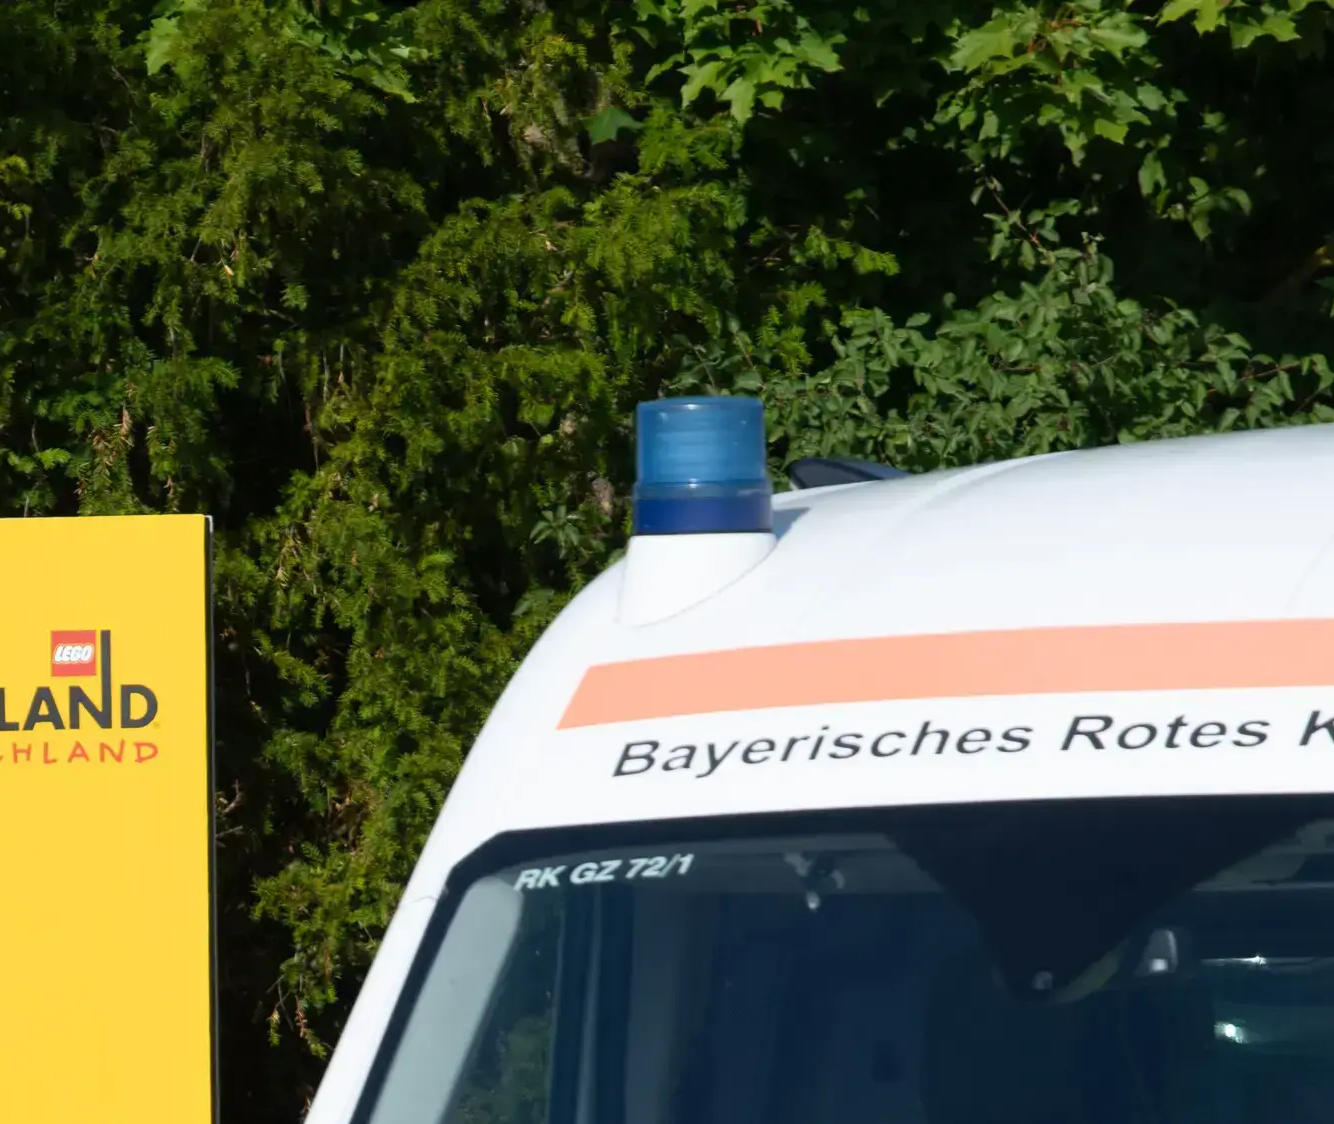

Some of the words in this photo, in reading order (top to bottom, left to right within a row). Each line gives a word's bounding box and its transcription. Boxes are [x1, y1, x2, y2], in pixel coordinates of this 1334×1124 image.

[53, 643, 94, 663] LEGO
[612, 718, 1032, 779] Bayerisches
[1059, 711, 1268, 753] Rotes
[513, 865, 567, 892] RK
[569, 859, 623, 885] GZ
[625, 853, 695, 880] 72/1
